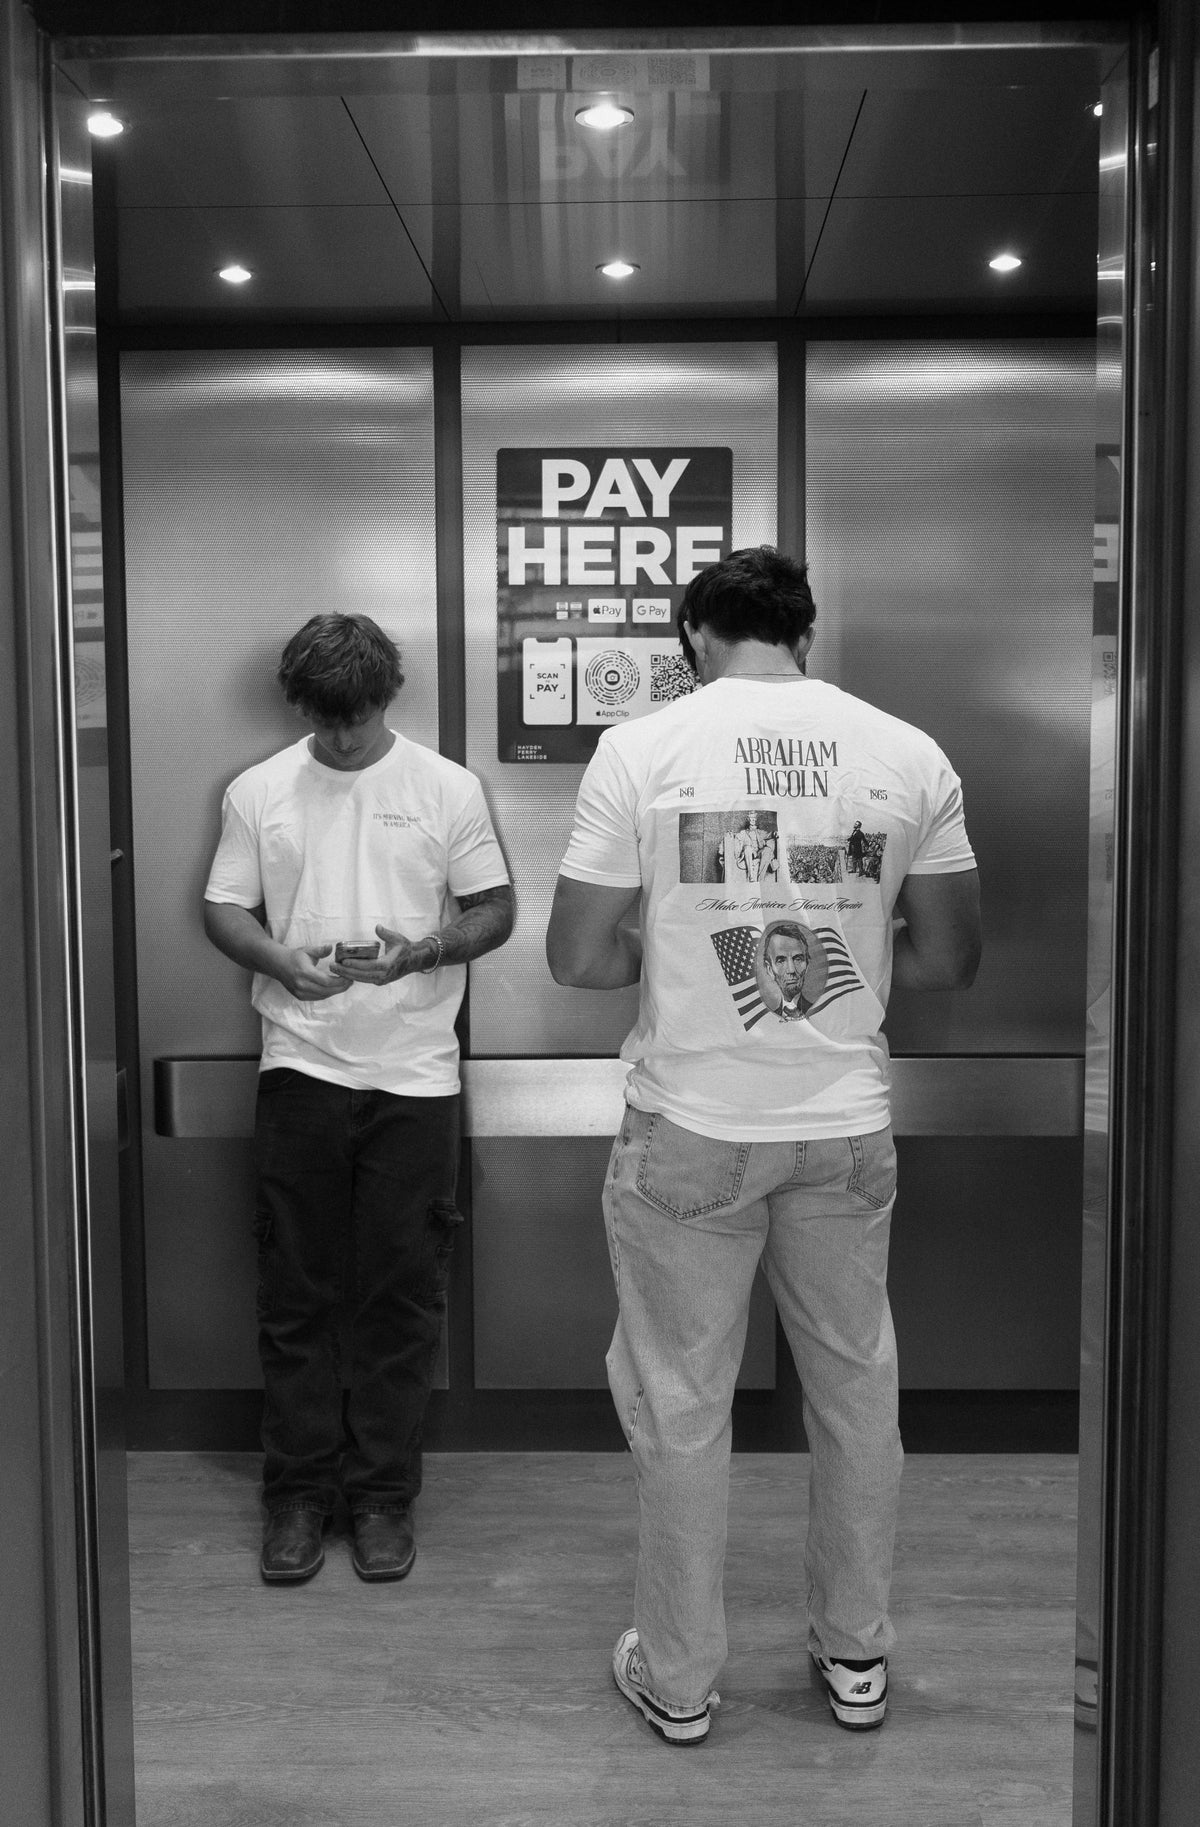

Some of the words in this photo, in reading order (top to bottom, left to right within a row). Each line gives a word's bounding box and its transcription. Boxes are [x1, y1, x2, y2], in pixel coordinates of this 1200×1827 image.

[541, 458, 691, 518] PAY
[508, 526, 723, 585] HERE
[602, 605, 622, 617] Pay
[637, 605, 646, 615] G
[649, 605, 667, 618] Pay
[537, 684, 559, 692] PAY
[734, 737, 839, 767] ABRAHAM
[744, 767, 828, 797] LINCOLN
[870, 789, 887, 800] 1865
[695, 898, 739, 912] Make
[740, 897, 787, 912] America
[788, 898, 835, 911] Honest
[833, 897, 863, 912] Again
